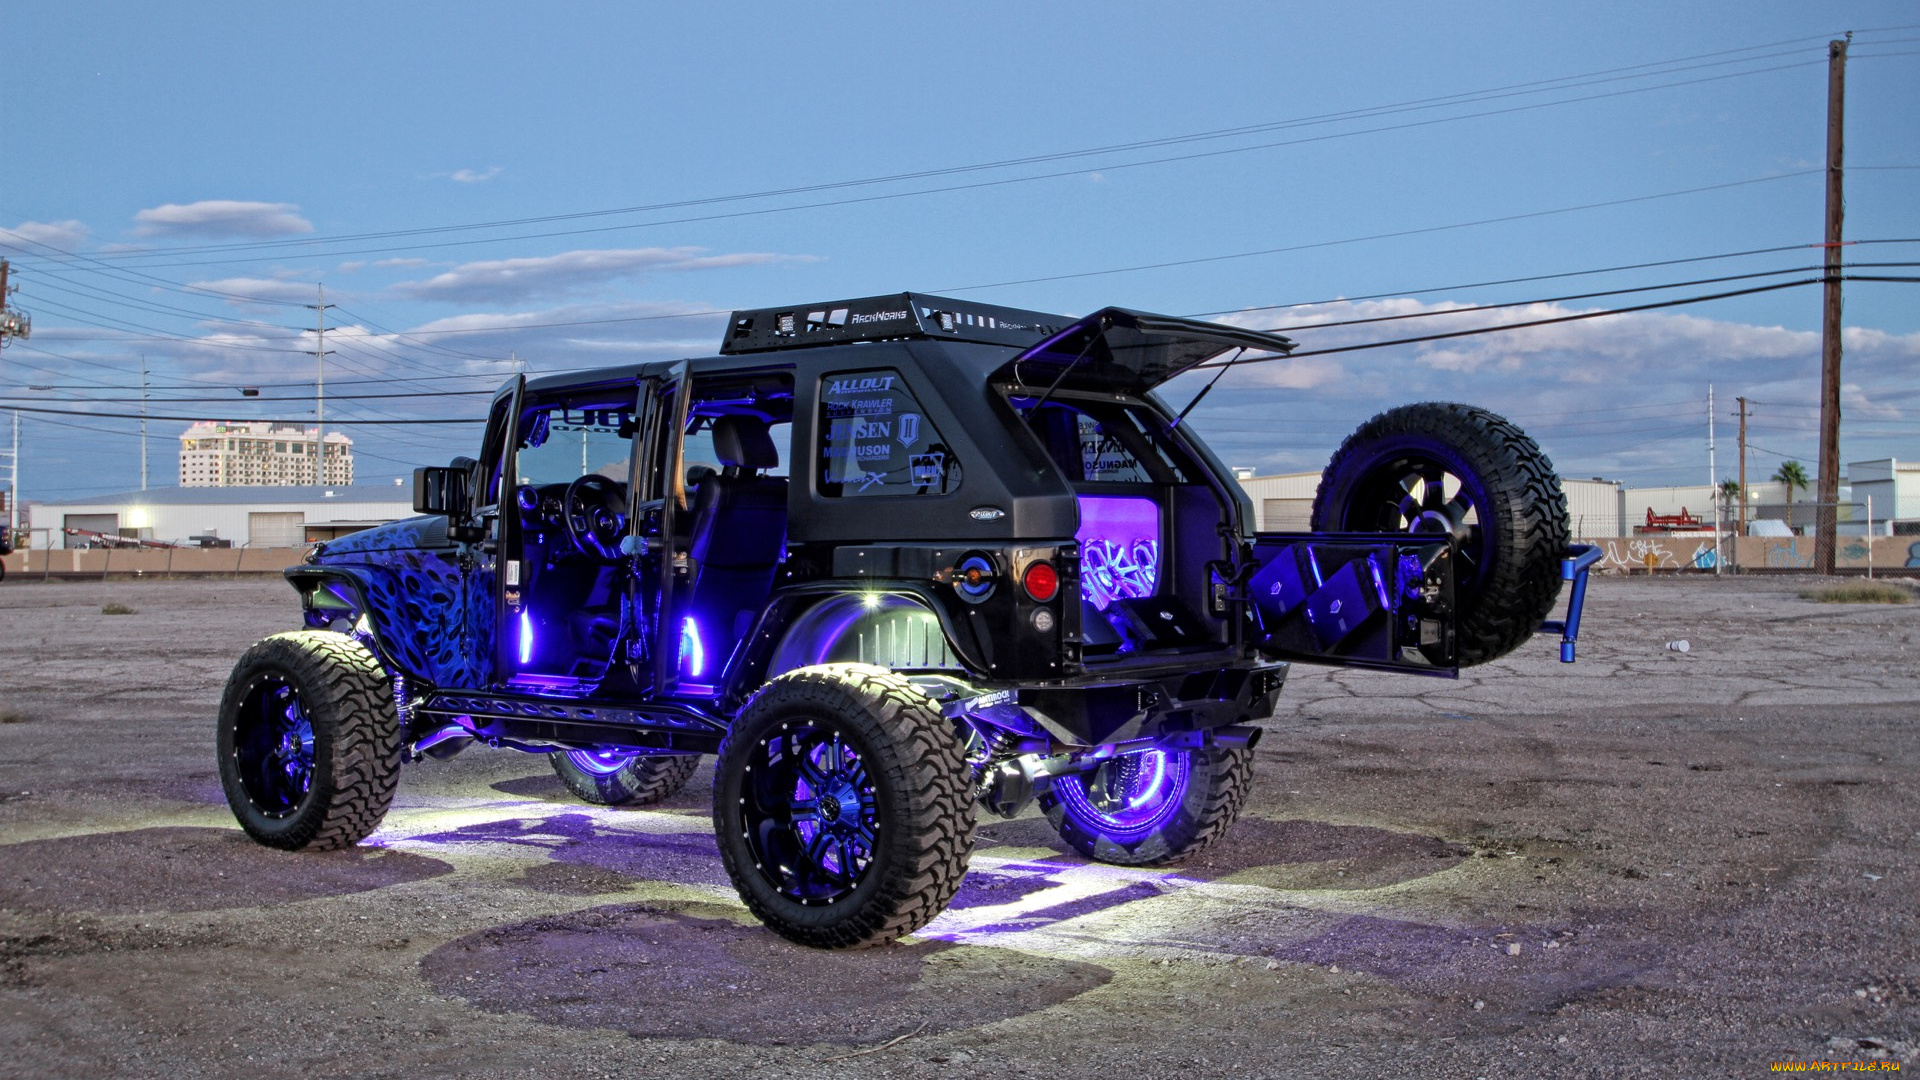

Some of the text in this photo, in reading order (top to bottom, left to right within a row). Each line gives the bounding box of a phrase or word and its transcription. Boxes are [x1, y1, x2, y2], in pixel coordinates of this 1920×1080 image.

[828, 377, 894, 394] ALLOUT
[827, 398, 893, 411] ROCK KRAWLER
[824, 445, 889, 457] MAGUSON
